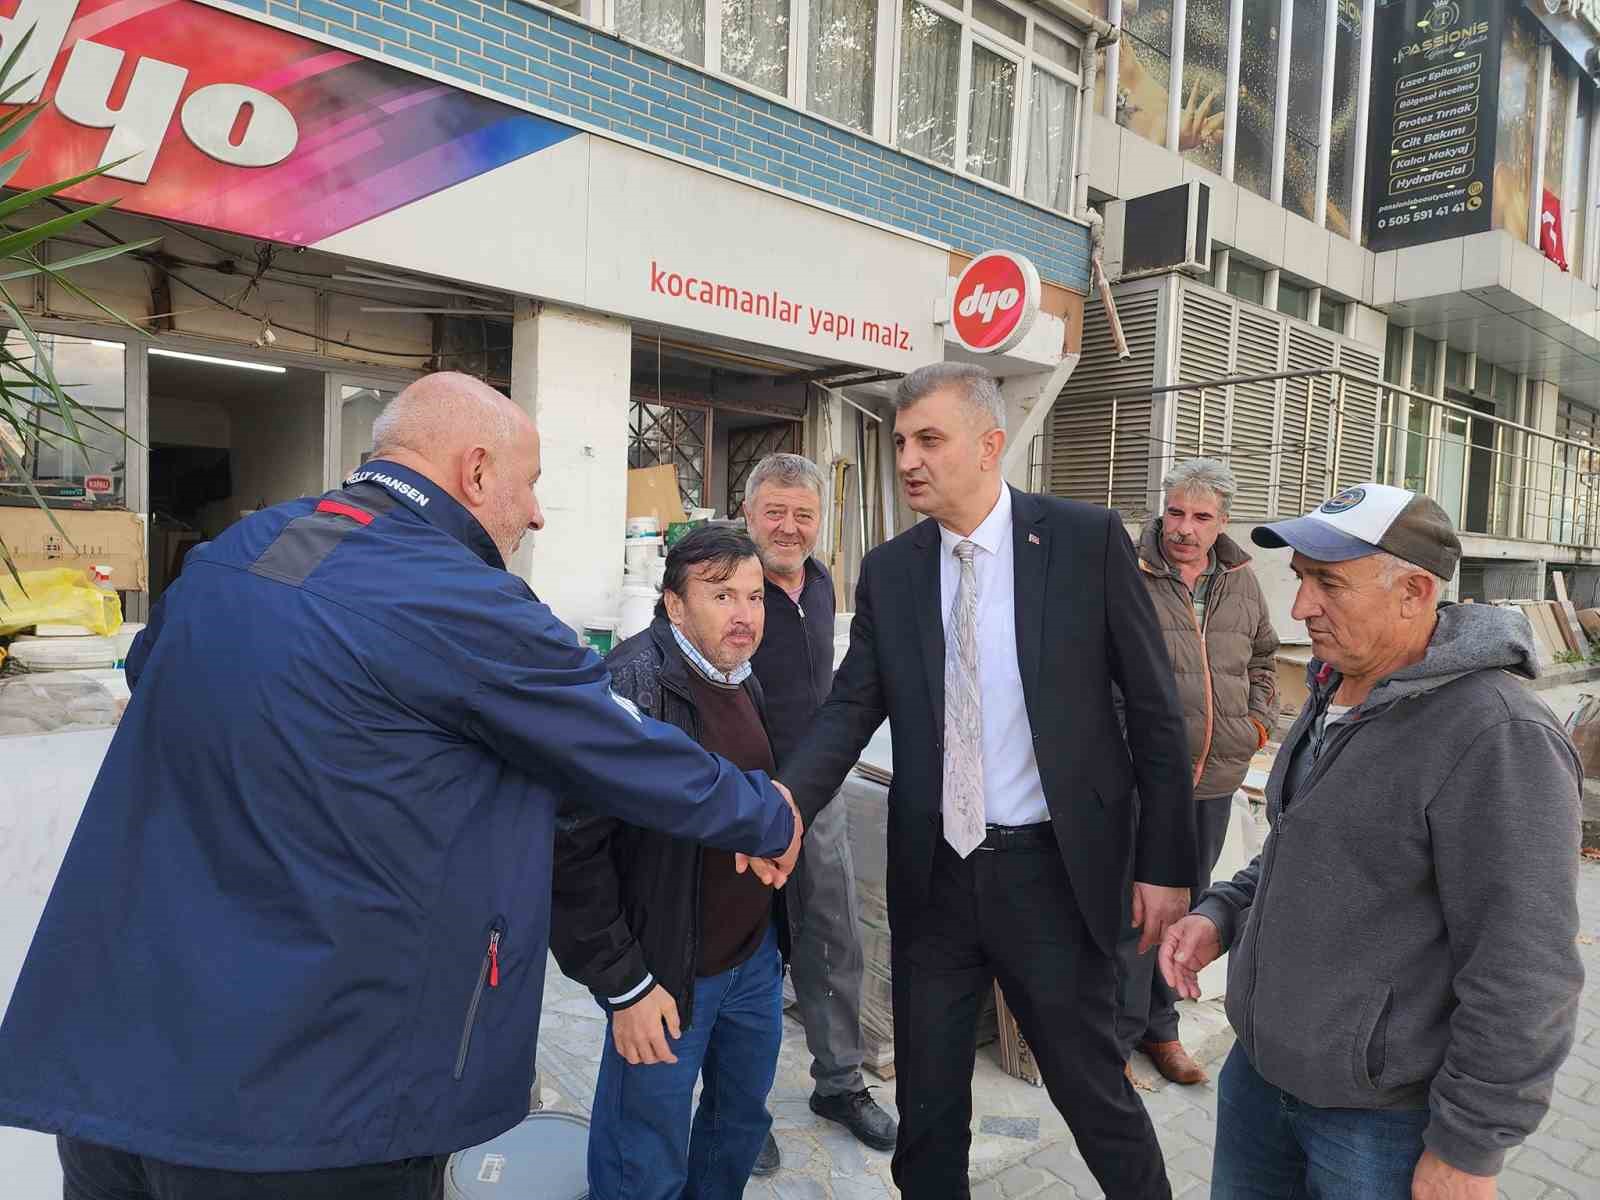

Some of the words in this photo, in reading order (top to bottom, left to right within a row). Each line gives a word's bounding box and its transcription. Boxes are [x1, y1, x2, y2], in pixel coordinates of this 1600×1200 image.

[1400, 76, 1427, 89] Lazer
[1428, 62, 1476, 81] Epilasyon
[1398, 114, 1433, 129] Protez
[1436, 103, 1472, 119] Tırnak
[1401, 137, 1421, 149] Cilt
[1423, 126, 1466, 143] Bakımı
[1428, 143, 1470, 160] Makyaj
[1396, 164, 1466, 188] Hydrafacial
[1378, 219, 1386, 229] 0
[1388, 214, 1410, 226] 505
[1413, 209, 1432, 221] 591
[1435, 205, 1449, 216] 41
[1452, 202, 1465, 212] 41
[650, 261, 802, 325] kocamanlar
[808, 307, 856, 341] yapı
[862, 319, 914, 351] malz.
[958, 283, 1020, 324] dyo
[371, 472, 430, 506] HANSEN
